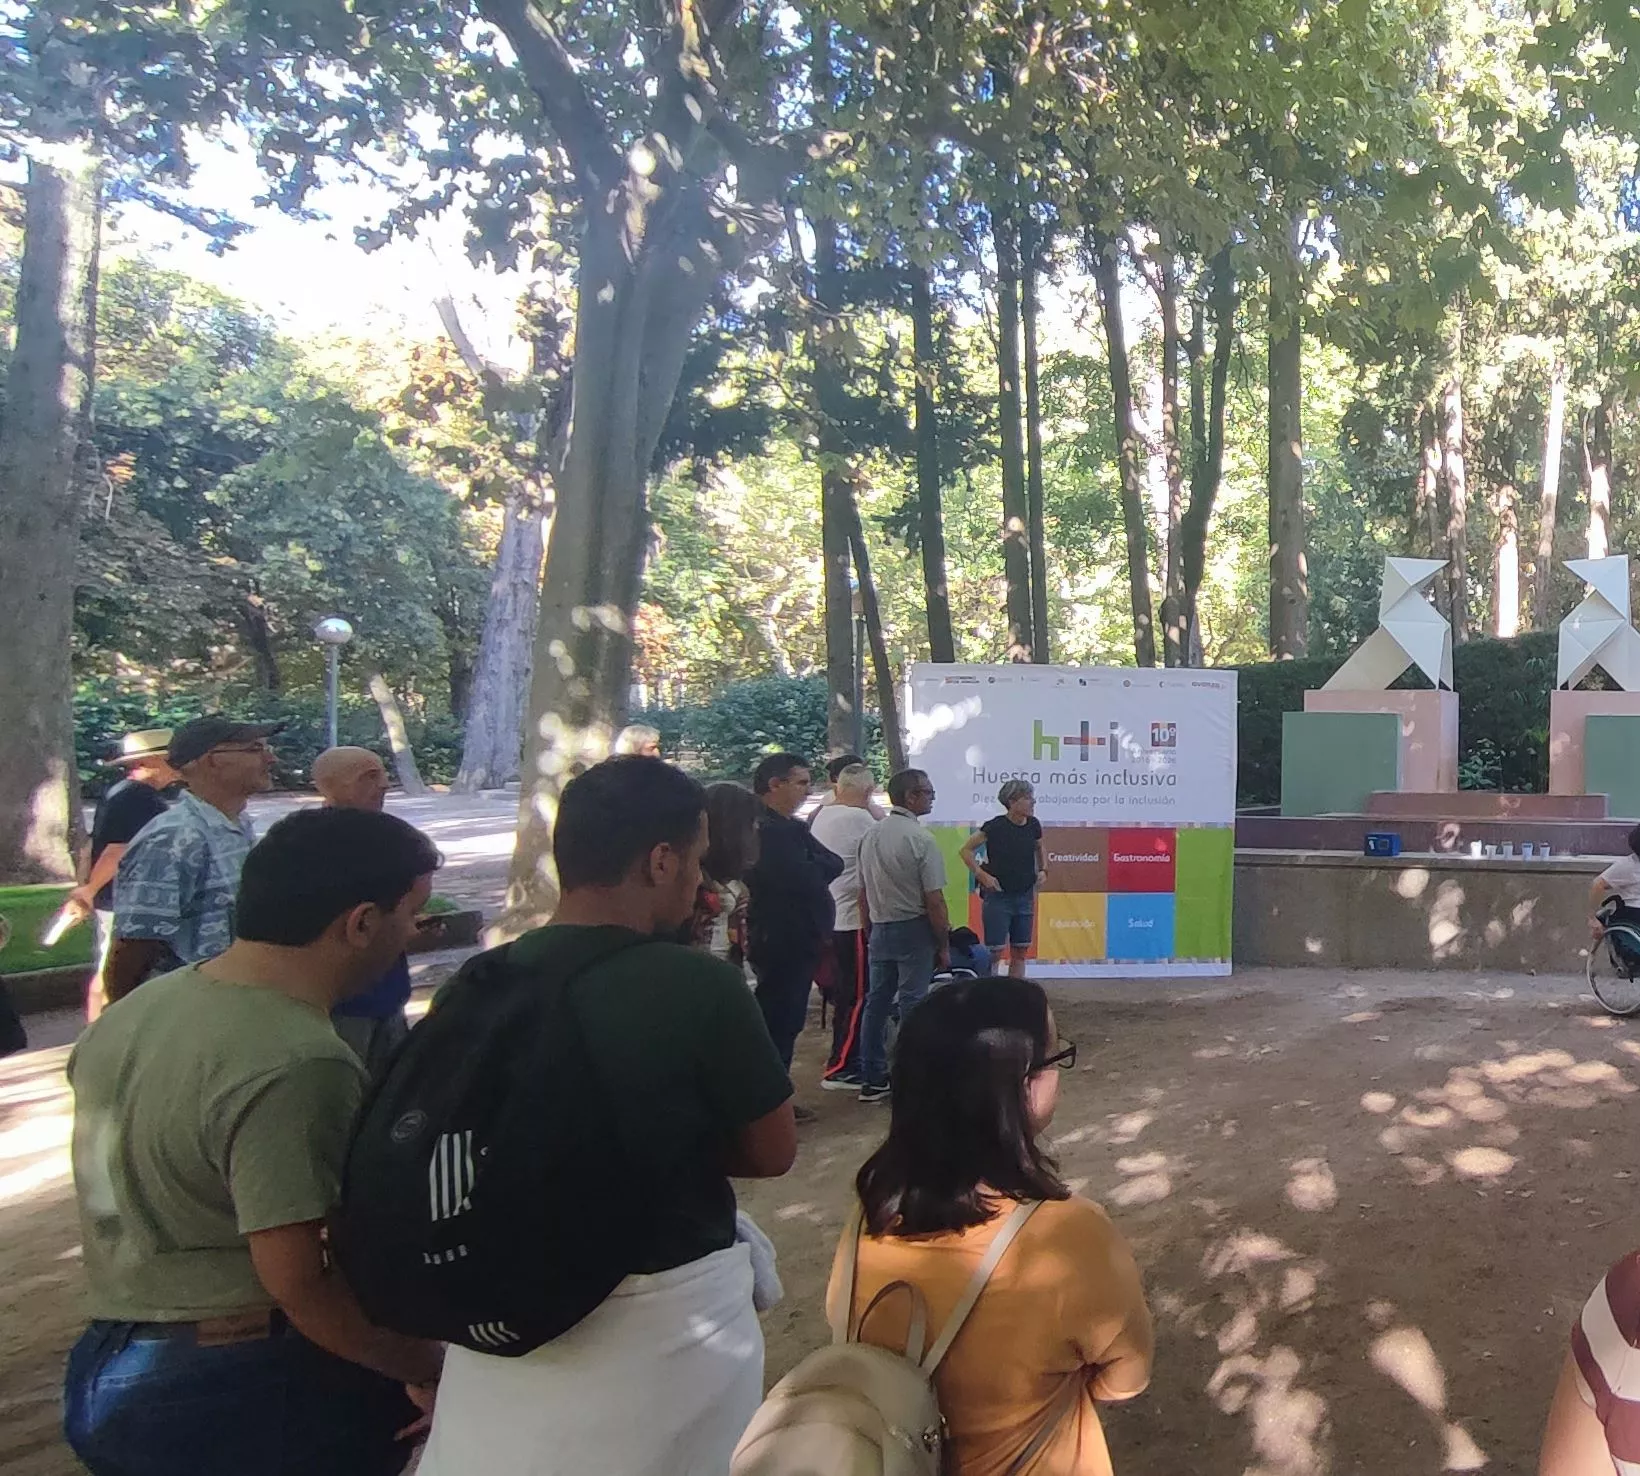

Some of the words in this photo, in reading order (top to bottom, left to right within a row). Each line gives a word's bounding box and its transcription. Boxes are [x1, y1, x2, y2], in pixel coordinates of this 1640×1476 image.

[972, 766, 1041, 785] Huesca
[1049, 767, 1088, 785] más
[1095, 768, 1177, 786] inclusiva
[972, 792, 996, 804] Diez
[1037, 794, 1090, 806] abajando
[1092, 796, 1110, 807] por
[1115, 795, 1125, 805] la
[1128, 795, 1176, 806] inclusión
[1047, 852, 1100, 862] Creatividad
[1113, 852, 1171, 863] Gastronomía
[1127, 917, 1154, 929] Salud
